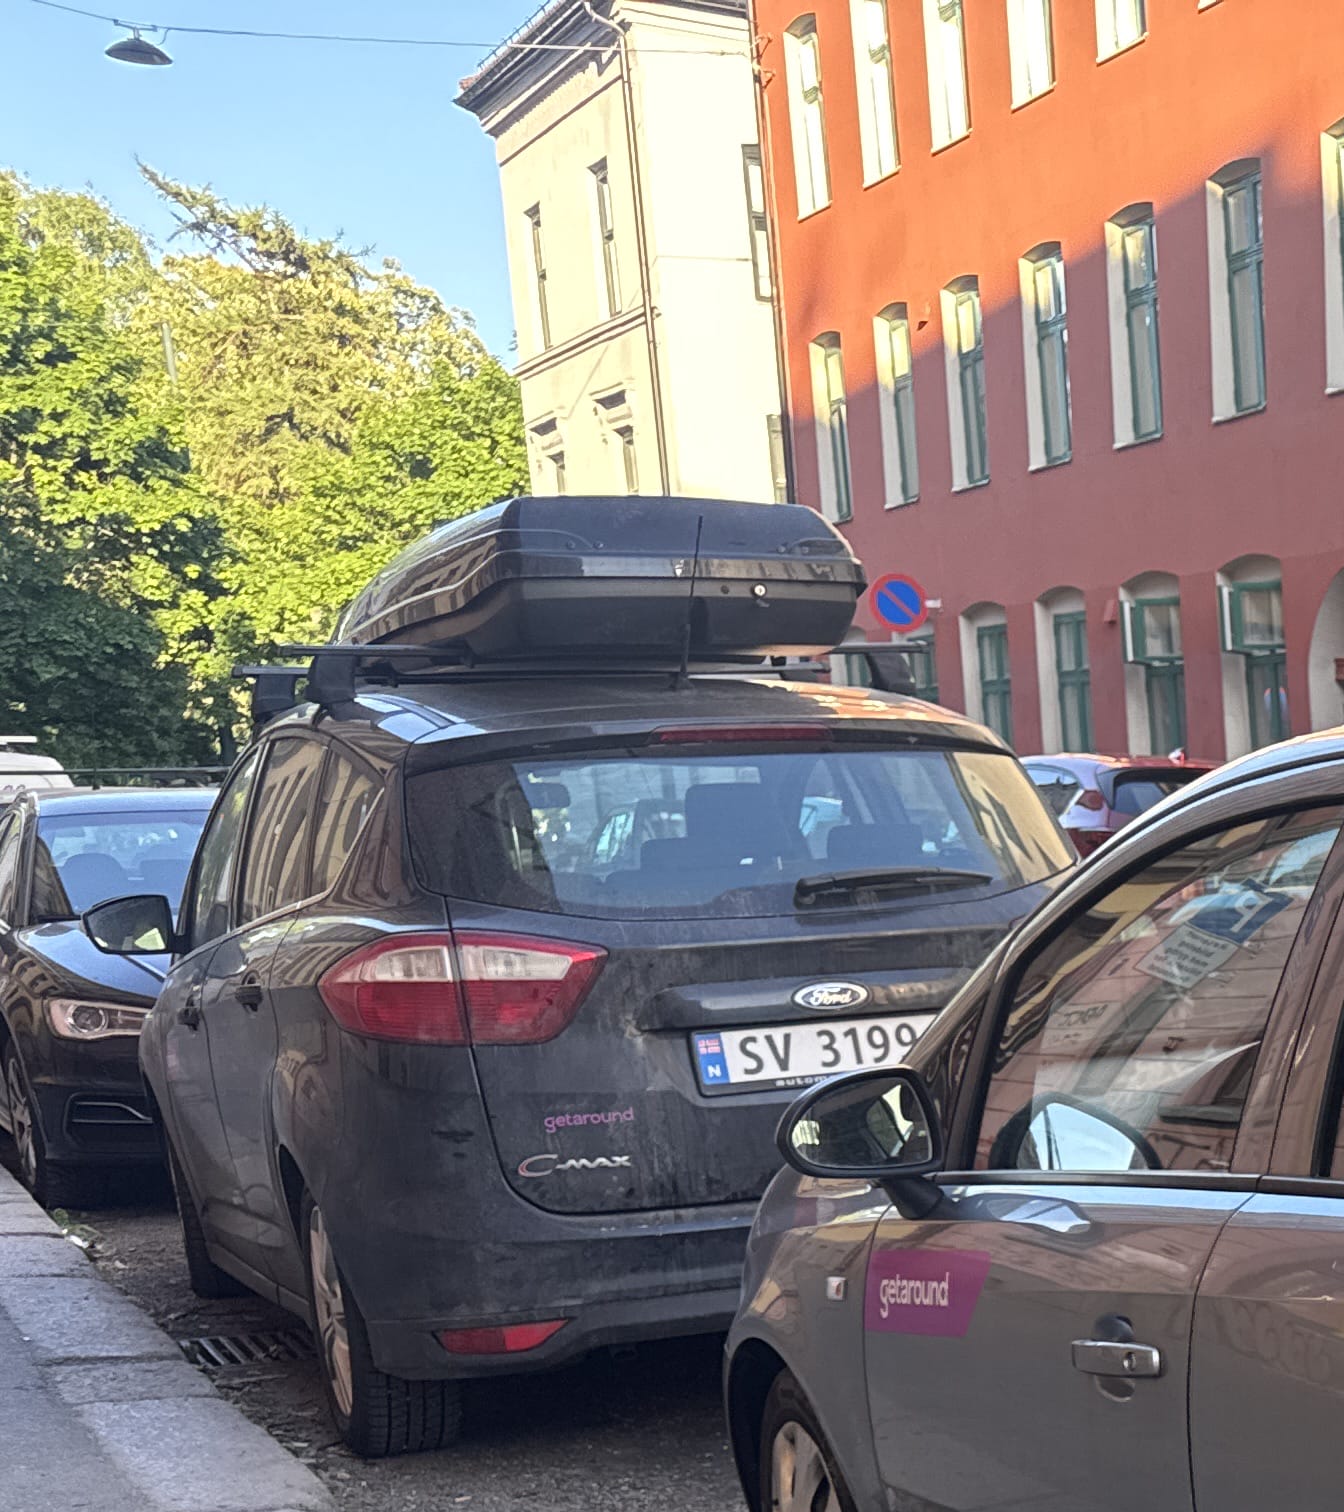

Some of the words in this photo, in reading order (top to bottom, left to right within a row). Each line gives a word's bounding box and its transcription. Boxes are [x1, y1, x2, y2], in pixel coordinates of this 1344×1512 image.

[809, 987, 852, 1006] Ford
[739, 1032, 791, 1075] SV
[816, 1022, 917, 1069] 3199
[707, 1064, 721, 1079] N
[543, 1105, 634, 1134] getaround
[879, 1271, 950, 1319] getaround
